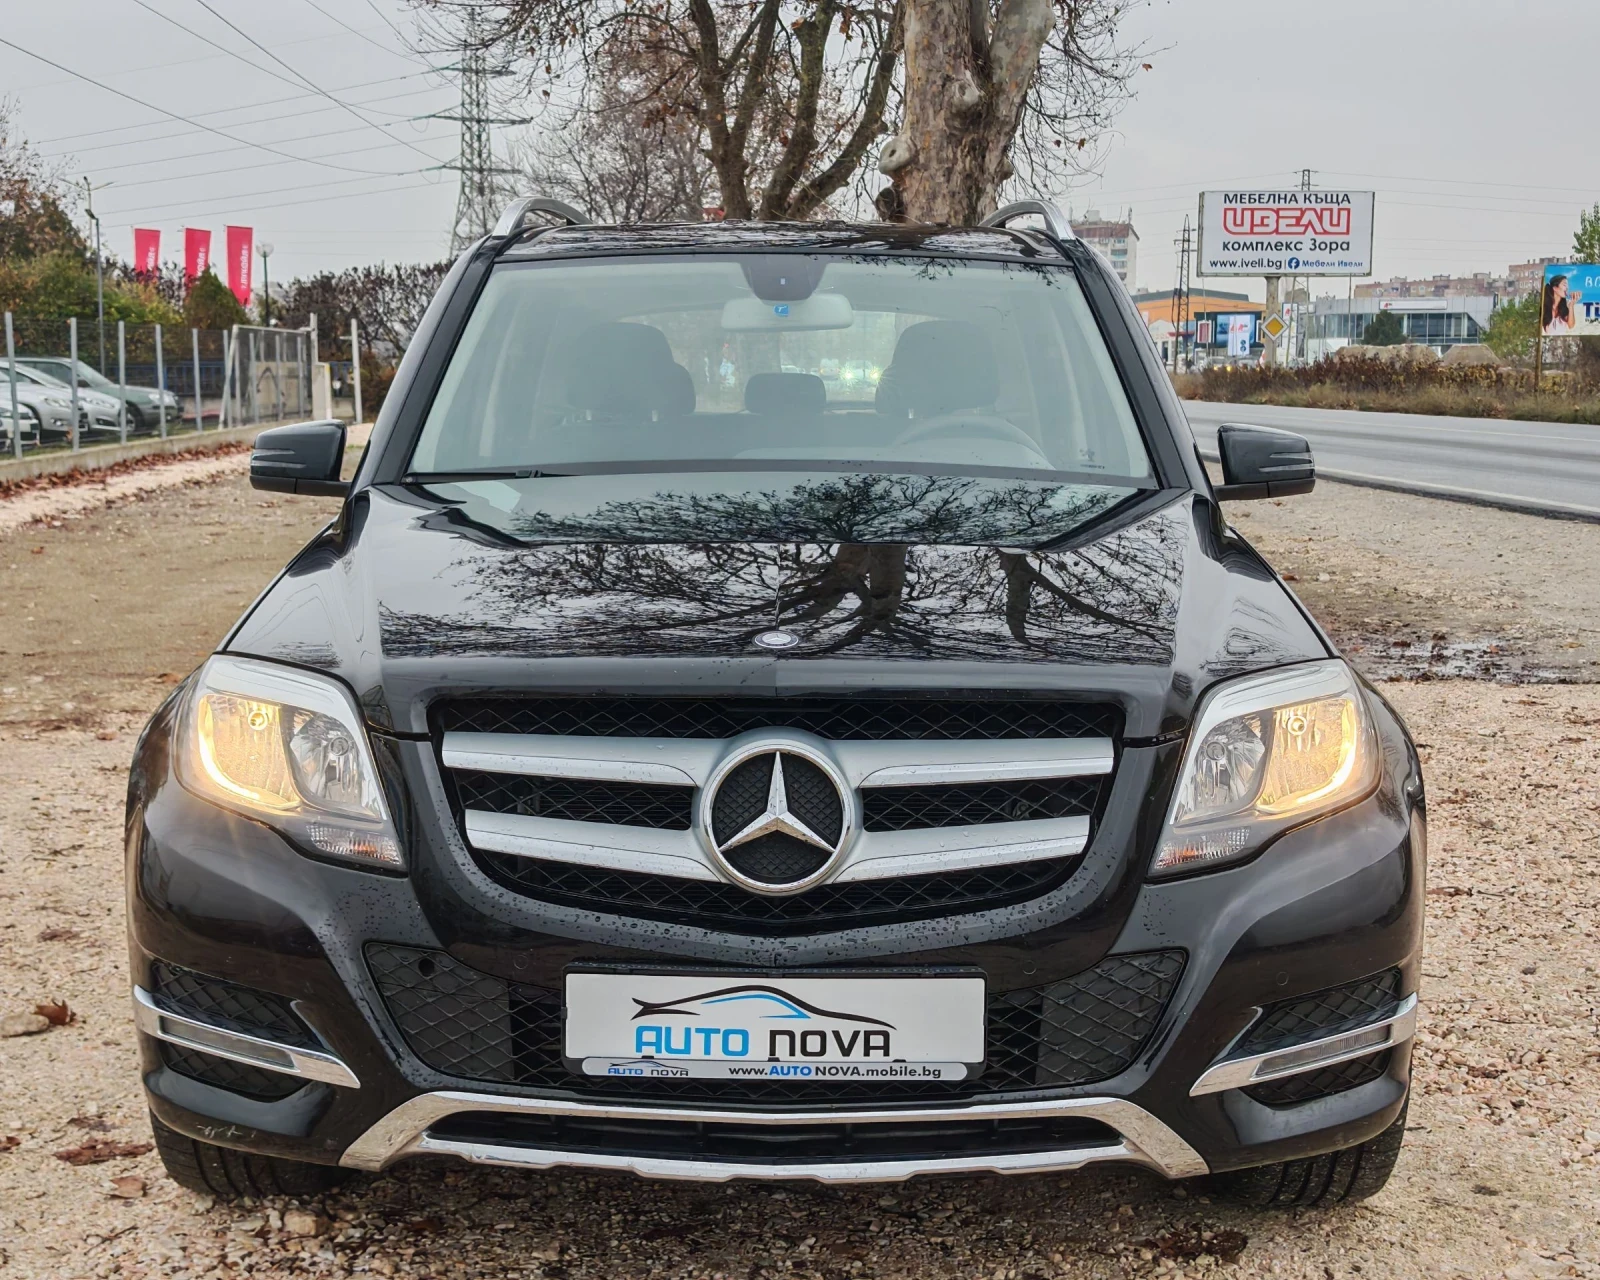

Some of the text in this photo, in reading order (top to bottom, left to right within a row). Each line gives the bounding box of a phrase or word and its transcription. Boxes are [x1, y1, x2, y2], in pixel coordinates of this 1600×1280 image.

[1224, 193, 1351, 206] МЕБЕЛНА КЪЩА
[1223, 207, 1351, 235] ИВЕЛИ
[1222, 238, 1351, 254] комплекс Зора
[1209, 257, 1282, 270] www.iveli.bg
[635, 1025, 891, 1058] AUTO NOVA
[608, 1067, 689, 1077] AUTO NOVA
